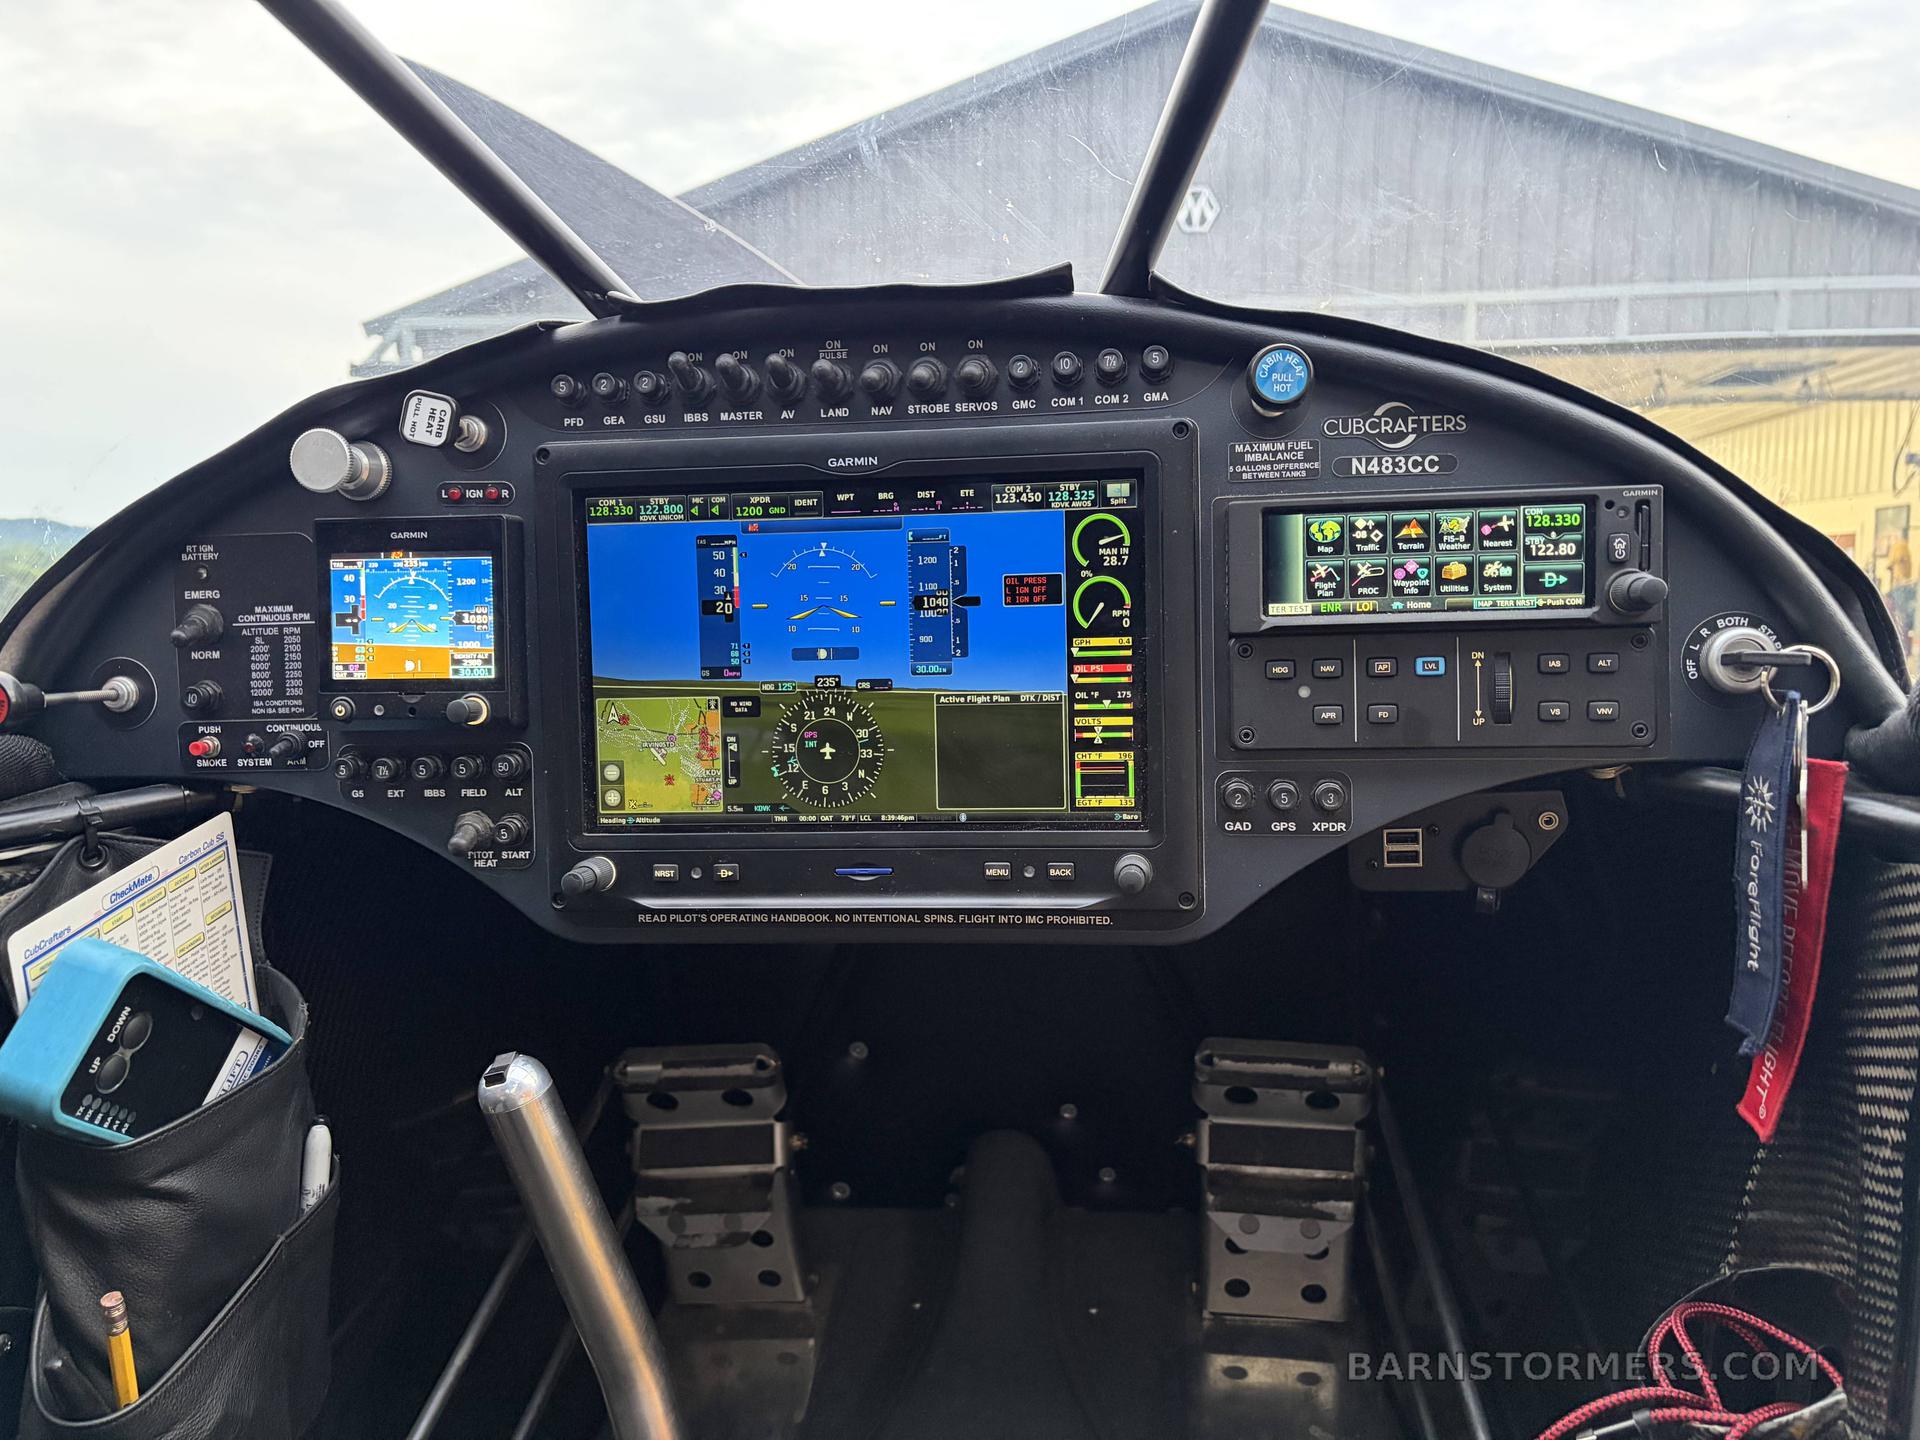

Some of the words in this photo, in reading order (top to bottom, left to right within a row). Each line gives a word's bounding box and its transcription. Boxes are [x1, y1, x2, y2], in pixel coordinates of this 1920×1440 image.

[826, 340, 841, 350] ON
[872, 344, 888, 353] ON
[920, 342, 936, 351] ON
[968, 340, 983, 349] ON
[819, 351, 848, 360] PULSE
[1272, 373, 1294, 382] PULL
[1273, 383, 1291, 393] HOT
[1095, 395, 1118, 405] COM
[1122, 394, 1129, 404] 2
[1143, 392, 1169, 402] GMA
[907, 403, 950, 414] STROBE
[955, 401, 998, 412] SERVOS
[1012, 399, 1036, 410] GMC
[720, 410, 763, 421] MASTER
[780, 410, 795, 420] AV
[820, 408, 849, 418] LAND
[871, 406, 893, 416] NAV
[426, 407, 437, 436] HEAT
[603, 415, 625, 425] GEA
[644, 414, 666, 424] GSU
[683, 412, 709, 422] IBBS
[435, 409, 447, 438] CARB
[564, 417, 584, 427] PFD
[1323, 415, 1466, 436] CUBCRAFTERS
[1235, 442, 1285, 453] MAXIMUM
[1288, 441, 1313, 450] FUEL
[1244, 451, 1304, 461] IMBALANCE
[828, 456, 878, 467] GARMIN
[1352, 455, 1440, 475] N483CC
[1242, 471, 1279, 480] BETWEEN
[1280, 470, 1306, 478] TANKS
[1059, 483, 1080, 492] STBY
[836, 493, 855, 502] WPT
[878, 492, 894, 500] BRG
[917, 490, 935, 499] DIST
[960, 489, 974, 497] ETE
[995, 492, 1042, 503] 123.450
[1048, 490, 1095, 501] 128.325
[650, 497, 669, 506] STBY
[750, 496, 771, 504] XPDR
[794, 498, 818, 507] IDENT
[1110, 497, 1126, 506] Split
[589, 506, 634, 516] 128.330
[639, 504, 684, 515] 122.800
[736, 507, 763, 516] 1200
[768, 507, 786, 515] GND
[1526, 514, 1581, 528] 128.330
[390, 531, 428, 540] GARMIN
[1525, 537, 1545, 545] STBY
[186, 545, 197, 553] RT
[1318, 546, 1333, 554] Map
[1356, 543, 1380, 552] Traffic
[1398, 542, 1424, 550] Terrain
[1439, 542, 1471, 551] Weather
[1530, 543, 1576, 556] 122.80
[181, 553, 219, 561] BATTERY
[713, 551, 725, 560] 50
[1103, 556, 1129, 566] 28.7
[713, 568, 725, 578] 40
[1315, 581, 1336, 589] Flight
[1393, 579, 1430, 588] Waypoint
[1484, 583, 1512, 592] System
[1403, 587, 1418, 595] Info
[1440, 585, 1469, 593] Utilities
[184, 590, 220, 599] EMERG
[254, 605, 293, 613] MAXIMUM
[1320, 604, 1342, 612] ENR
[1356, 603, 1373, 611] LOI
[1407, 601, 1432, 609] Home
[238, 614, 289, 623] CONTINUOUS
[290, 613, 310, 621] RPM
[1716, 616, 1749, 629] BOTH
[241, 627, 279, 636] ALTITUDE
[283, 627, 301, 635] RPM
[191, 651, 220, 659] NORM
[1272, 666, 1288, 674] HDG
[1686, 658, 1698, 680] OFF
[939, 695, 965, 703] Active
[967, 694, 989, 704] Flight
[991, 694, 1010, 702] Plan
[804, 711, 816, 720] 21
[824, 707, 836, 716] 24
[198, 726, 221, 734] PUSH
[856, 729, 869, 738] 30
[308, 740, 325, 748] OFF
[860, 749, 873, 758] 33
[196, 759, 227, 767] SMOKE
[237, 758, 272, 767] SYSTEM
[461, 789, 487, 797] FIELD
[1224, 822, 1251, 831] GAD
[1271, 822, 1296, 831] GPS
[1312, 822, 1346, 832] XPDR
[178, 847, 201, 864] Carbon
[202, 838, 215, 850] Cub
[216, 832, 224, 843] SS
[109, 873, 152, 904] CheckMate
[1747, 839, 1764, 972] ForeFlight
[638, 914, 667, 923] READ
[670, 914, 707, 923] PILOT'S
[710, 914, 768, 923] OPERATING
[771, 914, 832, 923] HANDBOOK.
[835, 914, 850, 923] NO
[852, 914, 921, 923] INTENTIONAL
[924, 914, 956, 923] SPINS.
[959, 915, 995, 924] FLIGHT
[998, 915, 1022, 924] INTO
[1025, 916, 1044, 924] IMC
[1047, 916, 1113, 925] PROHIBITED.
[24, 925, 72, 960] CubCrafters
[107, 1006, 132, 1043] DOWN
[89, 1056, 101, 1074] UP
